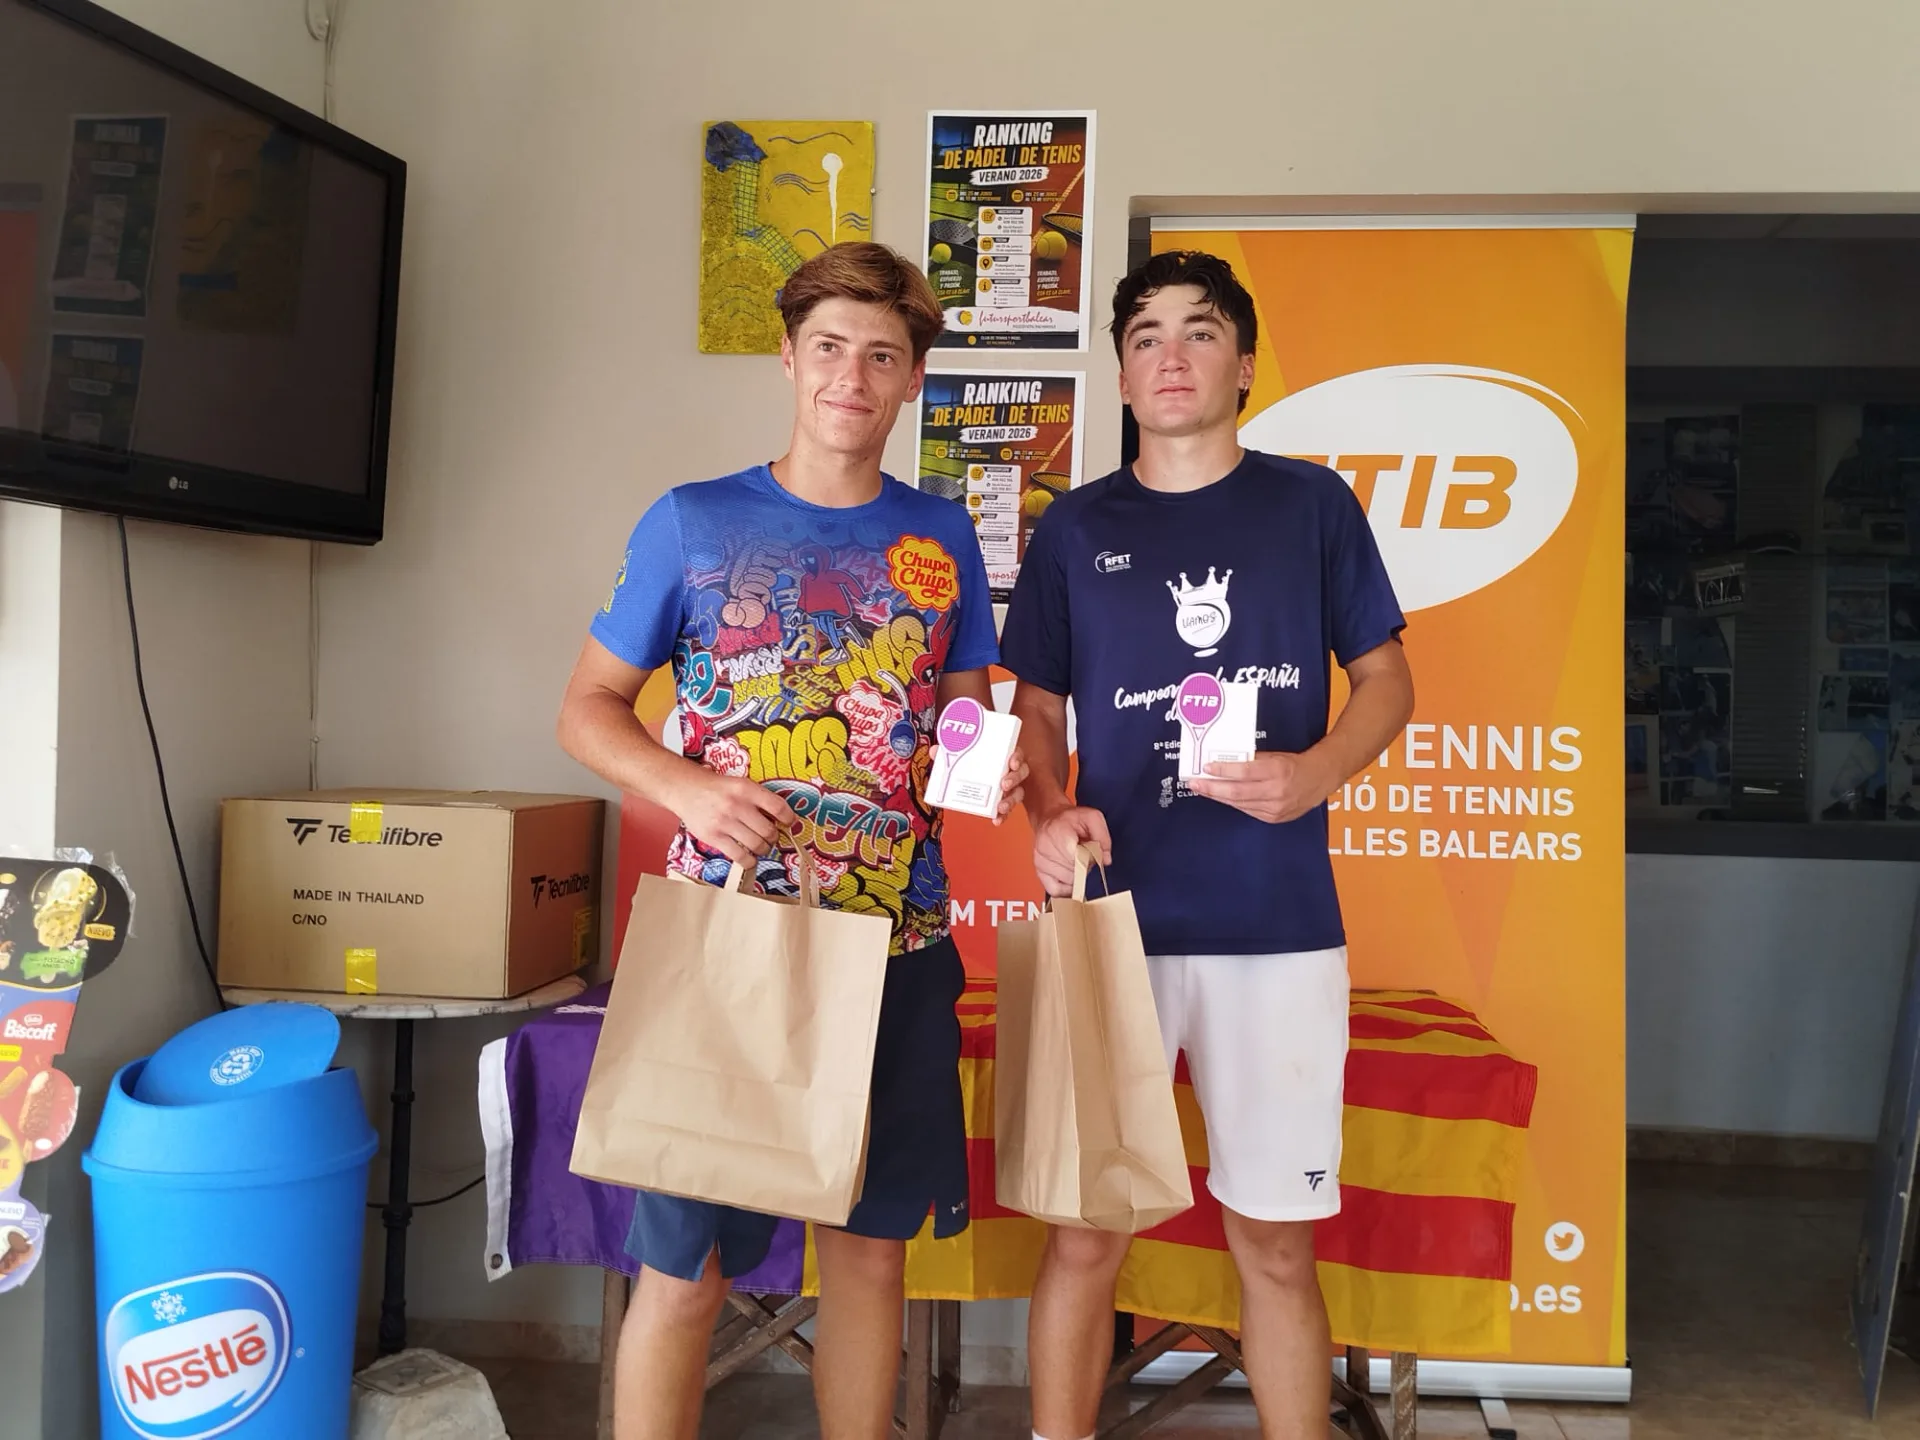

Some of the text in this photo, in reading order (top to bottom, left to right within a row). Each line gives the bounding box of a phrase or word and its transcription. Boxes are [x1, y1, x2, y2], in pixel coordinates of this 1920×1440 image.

[973, 122, 1053, 147] RANKING
[943, 144, 1082, 169] DE PÁDEL DE TENIS
[979, 168, 1043, 182] VERANO 2026
[963, 381, 1043, 405] RANKING
[933, 404, 1070, 427] DE PÁDEL DE TENIS
[968, 427, 1031, 440] VERANO 2026
[1282, 454, 1518, 530] TIB
[900, 550, 951, 574] Chupa
[1105, 554, 1131, 566] RFET
[900, 567, 952, 598] Chups
[1234, 663, 1300, 690] ESPAÑA
[844, 699, 884, 719] Chupa
[1182, 695, 1219, 708] FTIB
[942, 718, 977, 735] FTIB
[1378, 724, 1583, 772] ENNIS
[1388, 784, 1433, 813] DE
[1443, 786, 1575, 817] TENNIS
[327, 825, 443, 847] Teifibre
[1419, 829, 1583, 861] BALEARS
[293, 889, 424, 905] MADE IN THAILAND
[292, 913, 327, 926] C/NO
[4, 1019, 57, 1041] Biscoff
[124, 1323, 268, 1404] Nestlé
